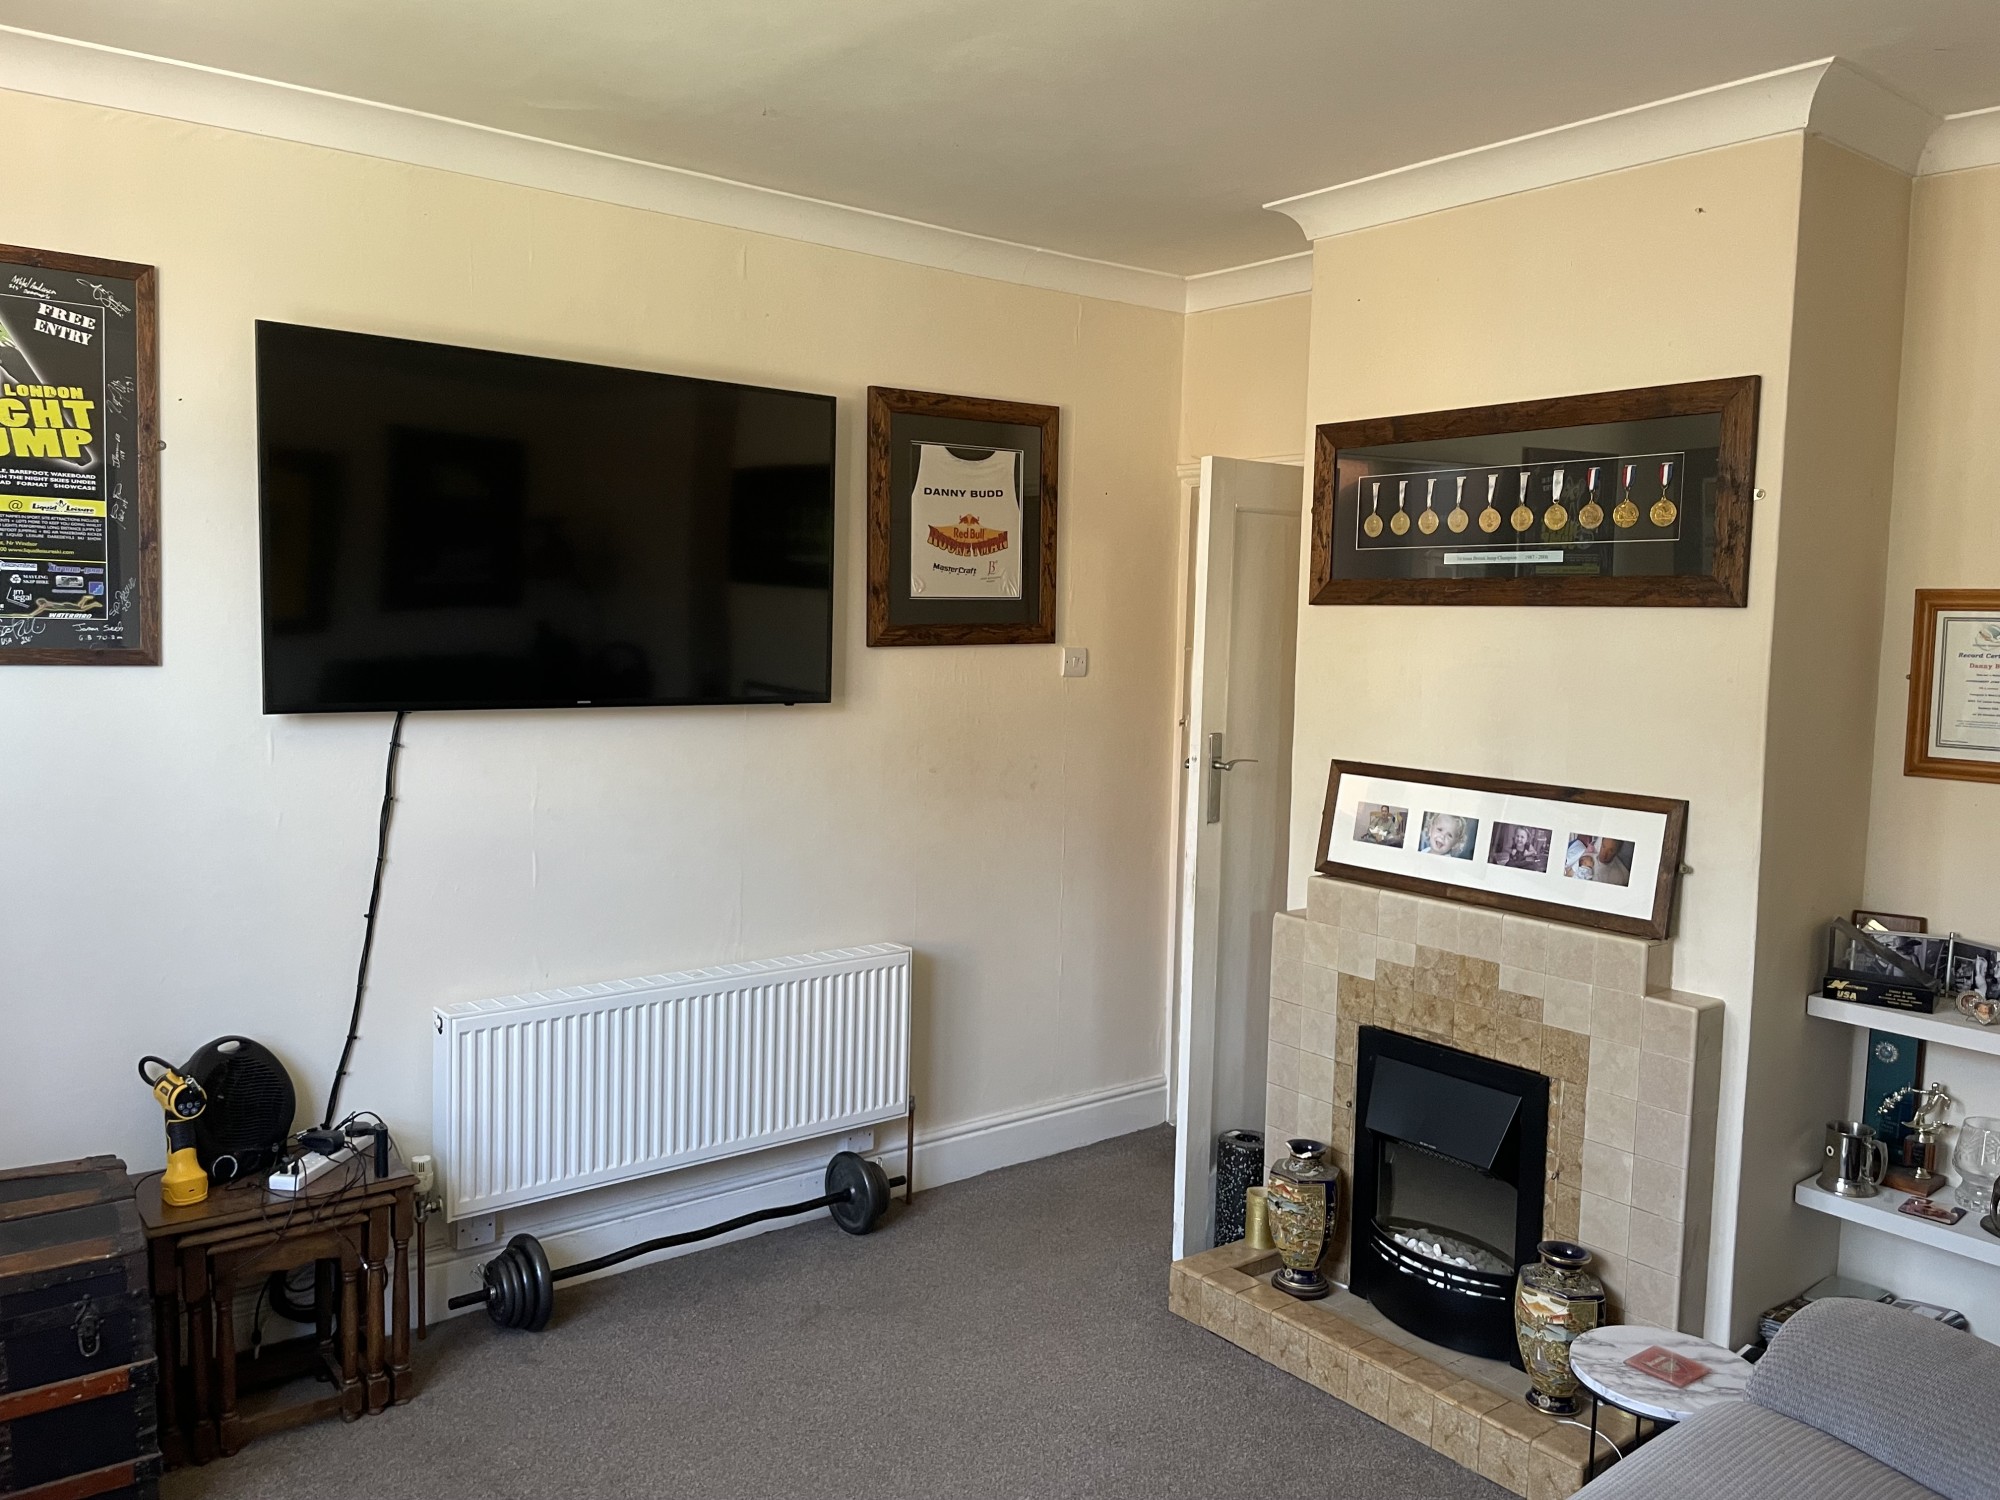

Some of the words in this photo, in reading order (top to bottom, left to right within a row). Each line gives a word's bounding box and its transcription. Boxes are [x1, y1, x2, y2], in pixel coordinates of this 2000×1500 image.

[37, 302, 96, 330] FREE
[33, 318, 93, 346] ENTRY
[3, 383, 84, 399] LONDON
[50, 471, 96, 480] WAKEBOARD
[53, 483, 96, 491] SHOWCASE
[923, 487, 967, 498] DANNY
[970, 489, 1004, 498] BUDD
[32, 503, 57, 511] Liquid
[66, 505, 95, 513] Leisure
[953, 527, 969, 538] Red
[970, 528, 985, 540] Bull
[932, 562, 977, 575] MasterCraft
[1969, 662, 1993, 671] Danny
[1837, 990, 1857, 1001] USA
